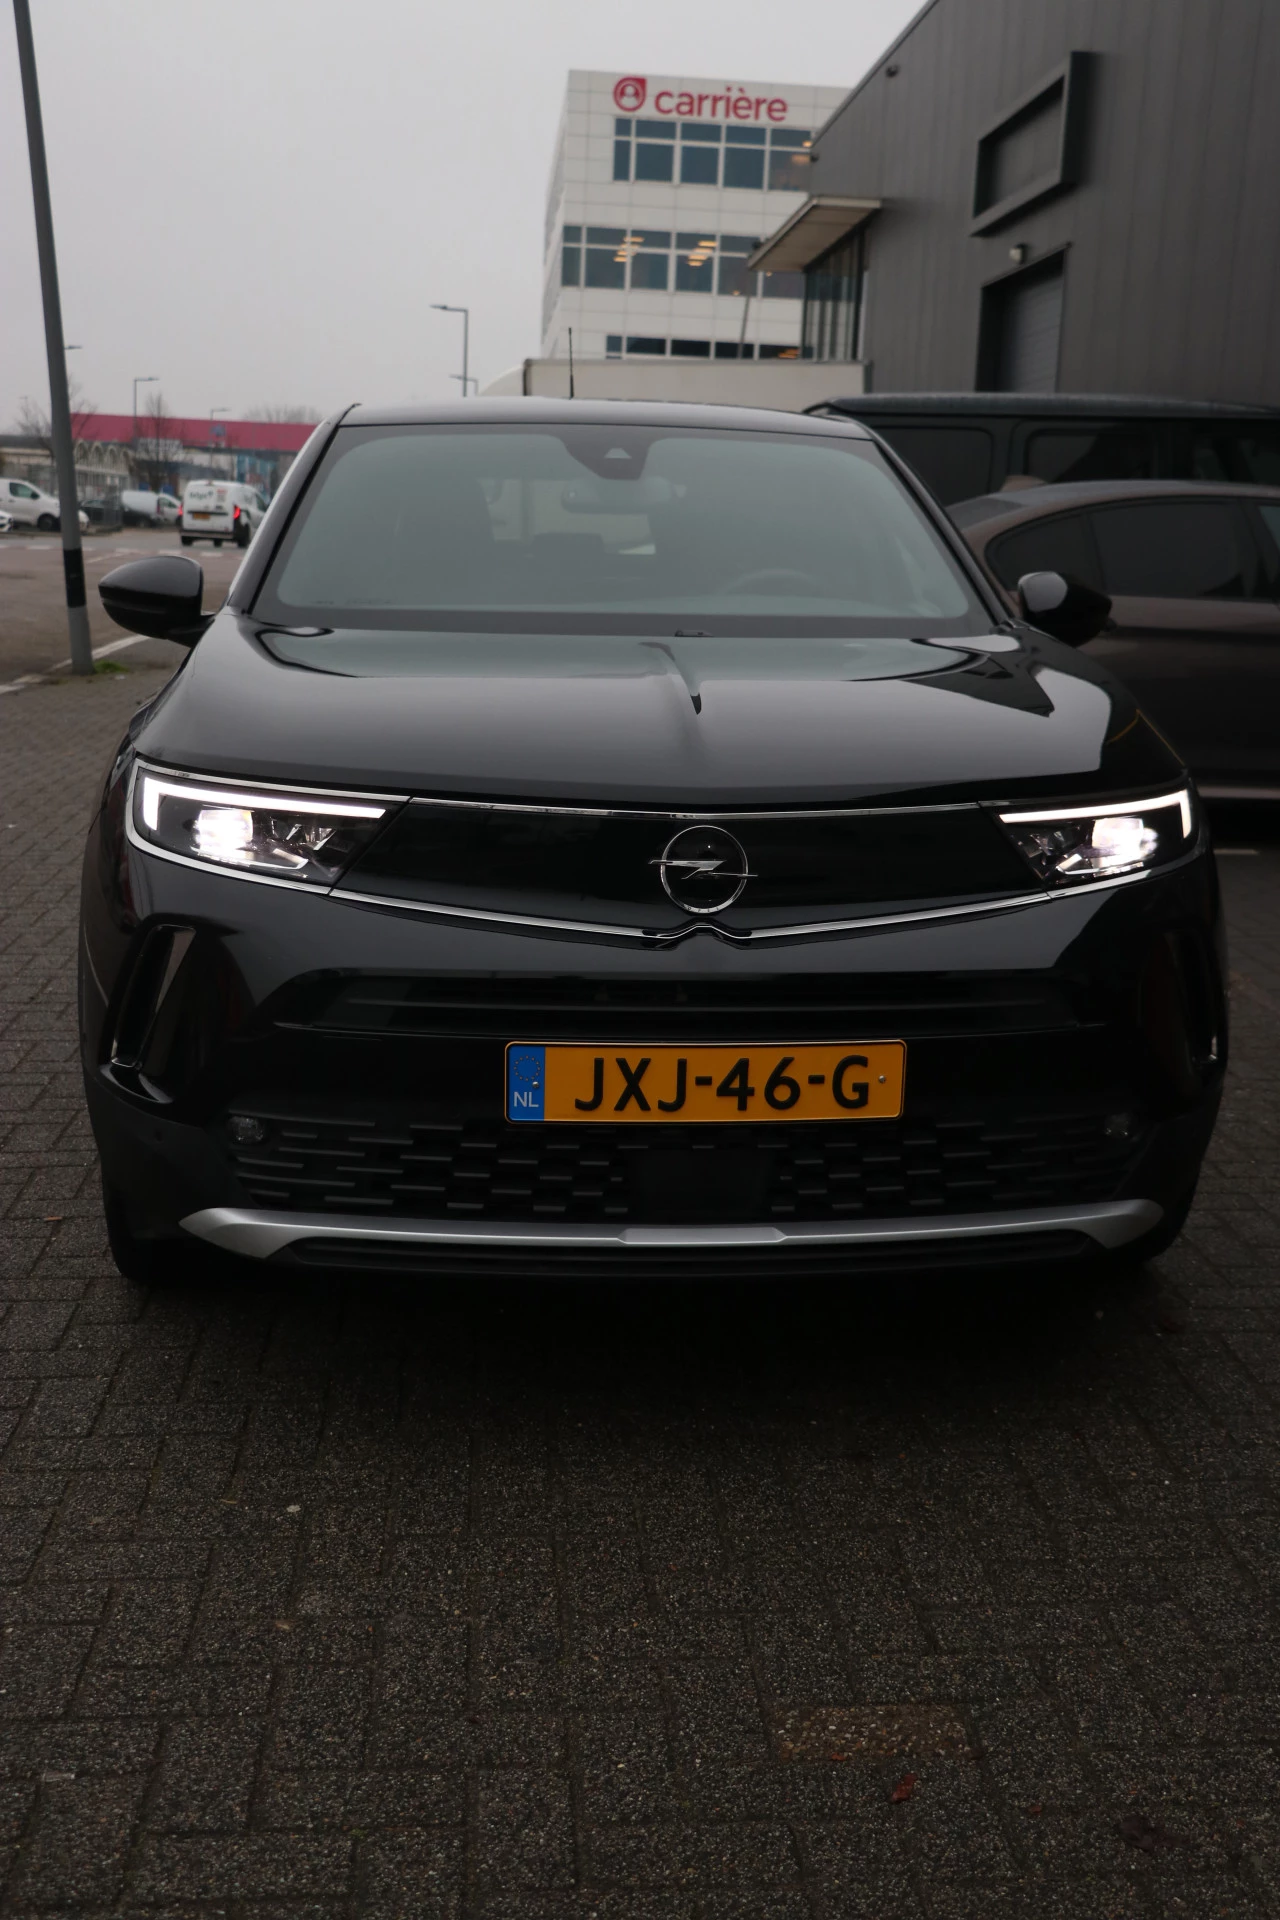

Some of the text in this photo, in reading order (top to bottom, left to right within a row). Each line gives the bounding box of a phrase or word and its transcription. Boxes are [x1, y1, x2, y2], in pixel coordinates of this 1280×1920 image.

[654, 86, 787, 122] carrière
[513, 1091, 539, 1108] NL
[574, 1055, 869, 1112] JXJ-46-G
